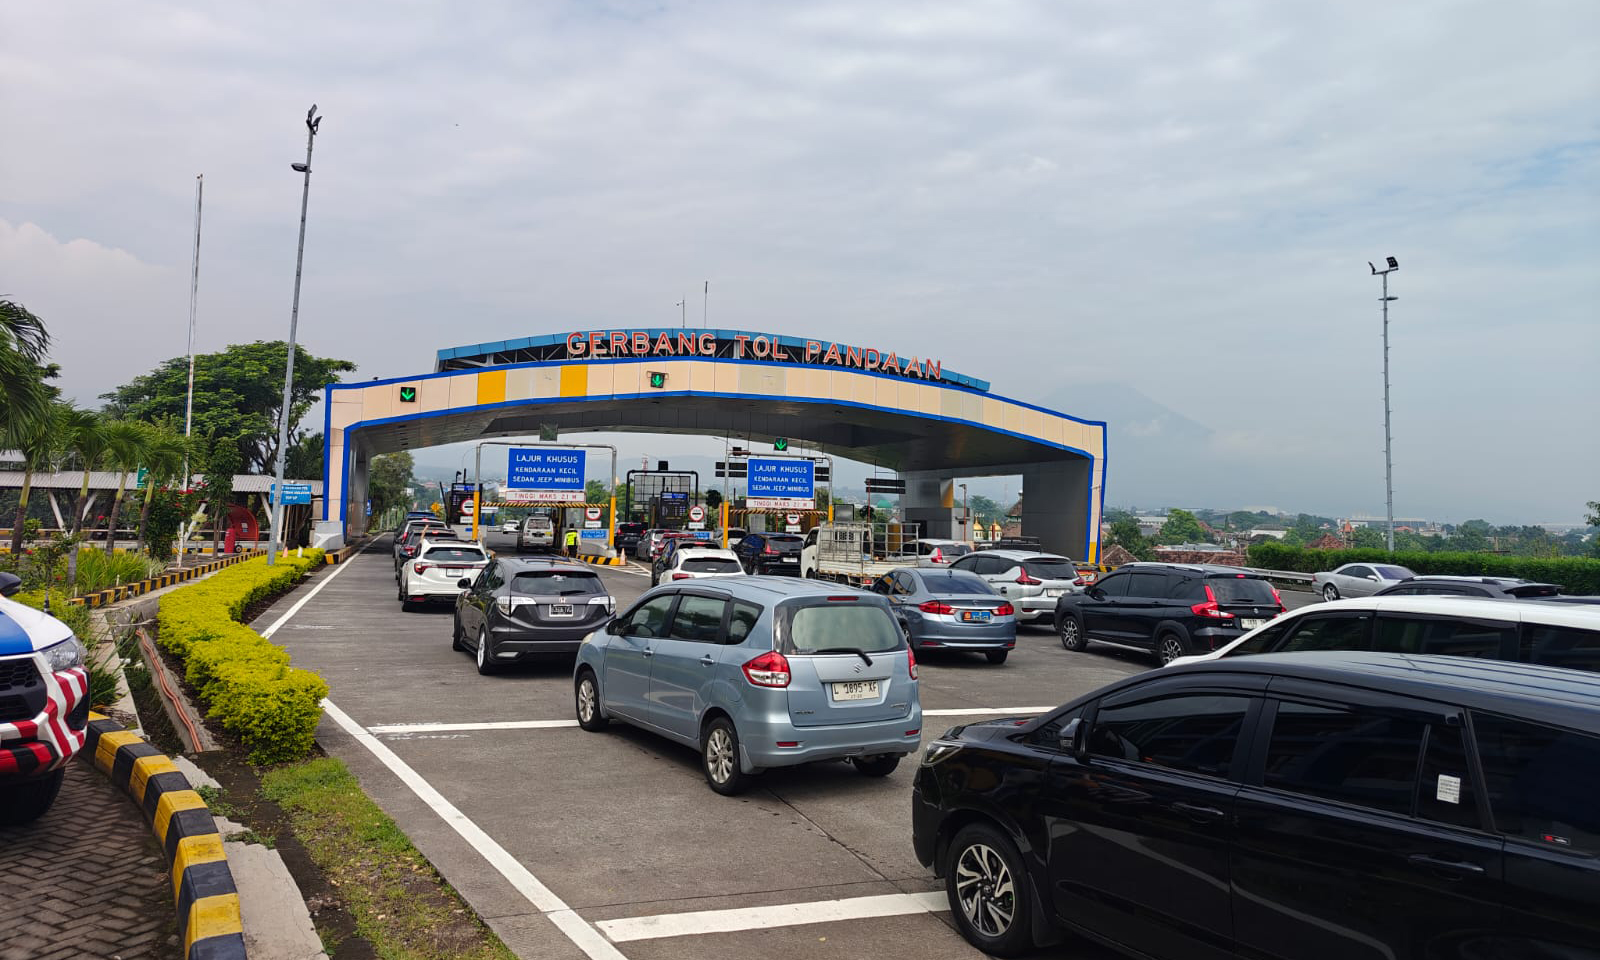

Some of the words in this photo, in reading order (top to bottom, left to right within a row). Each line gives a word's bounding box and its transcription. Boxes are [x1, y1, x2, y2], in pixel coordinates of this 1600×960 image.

[566, 331, 717, 355] GERBANG
[735, 335, 788, 359] TOL
[805, 339, 941, 380] PANDAAN
[516, 454, 542, 462] LAJUR
[546, 455, 578, 464] KHUSUS
[780, 466, 808, 474] KHUSUS
[834, 684, 839, 694] L
[843, 683, 863, 694] 1895
[868, 682, 876, 692] XF
